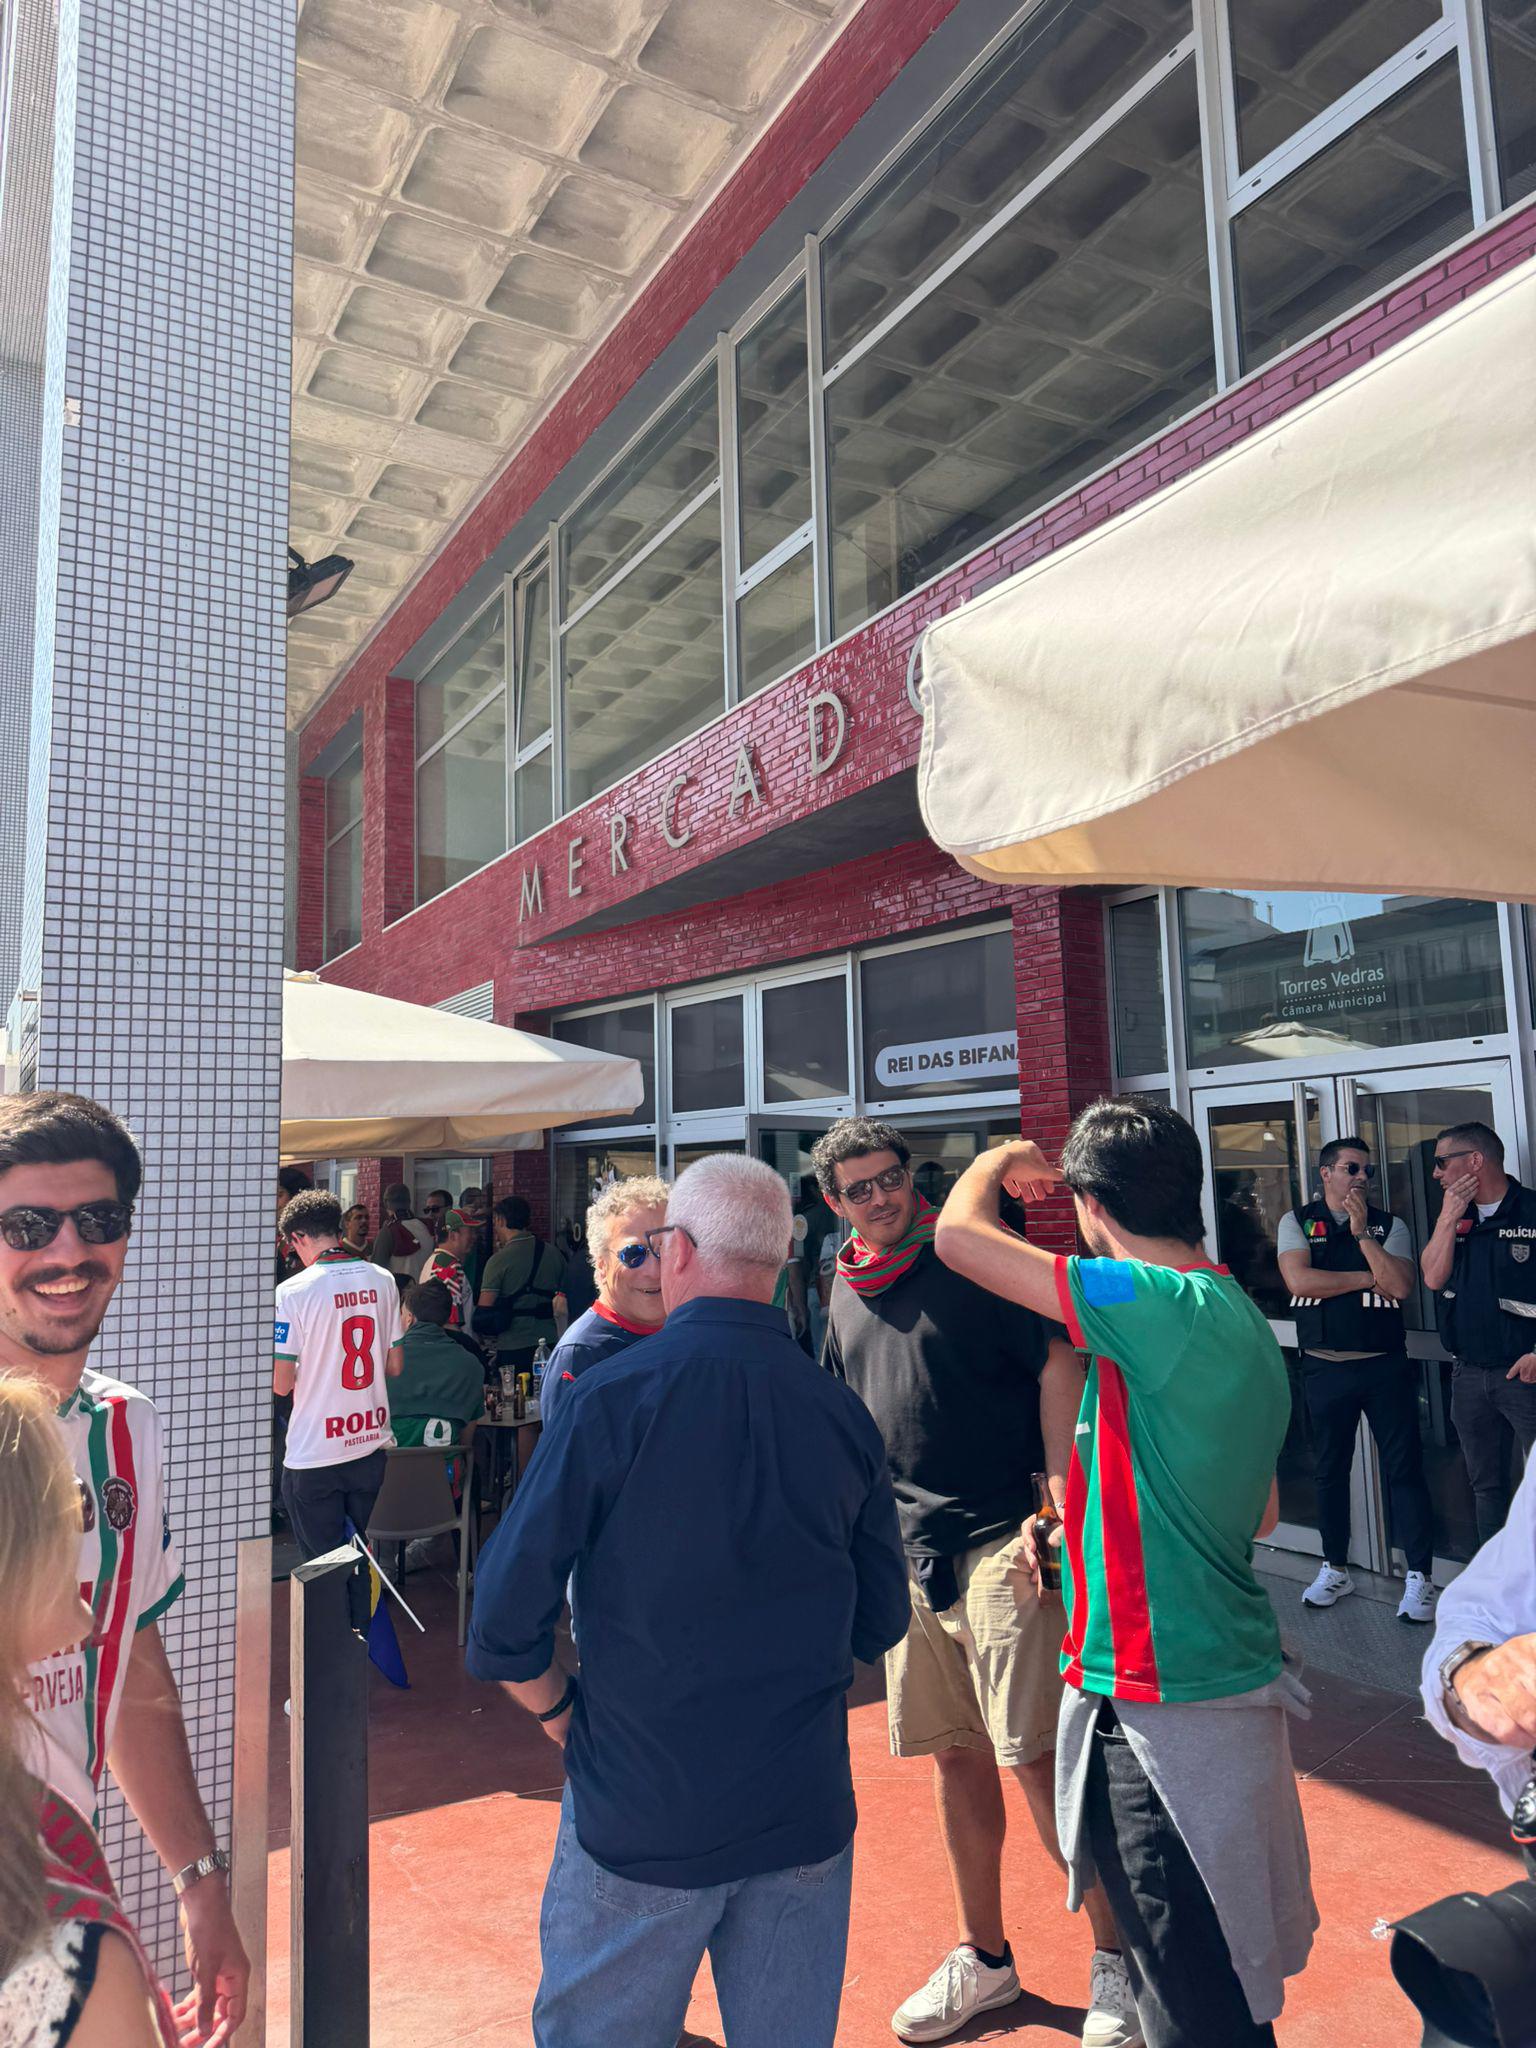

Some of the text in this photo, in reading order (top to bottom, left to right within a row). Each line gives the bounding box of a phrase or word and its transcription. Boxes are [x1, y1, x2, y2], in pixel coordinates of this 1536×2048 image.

[1280, 967, 1384, 996] Torres Vedras
[1281, 992, 1386, 1017] Câmara Municipal
[887, 1043, 1018, 1074] REI DAS BIFAN
[334, 1289, 378, 1309] DIOGO
[341, 1315, 375, 1391] 8
[326, 1407, 387, 1439] ROLO
[23, 1664, 84, 1712] RVEJA
